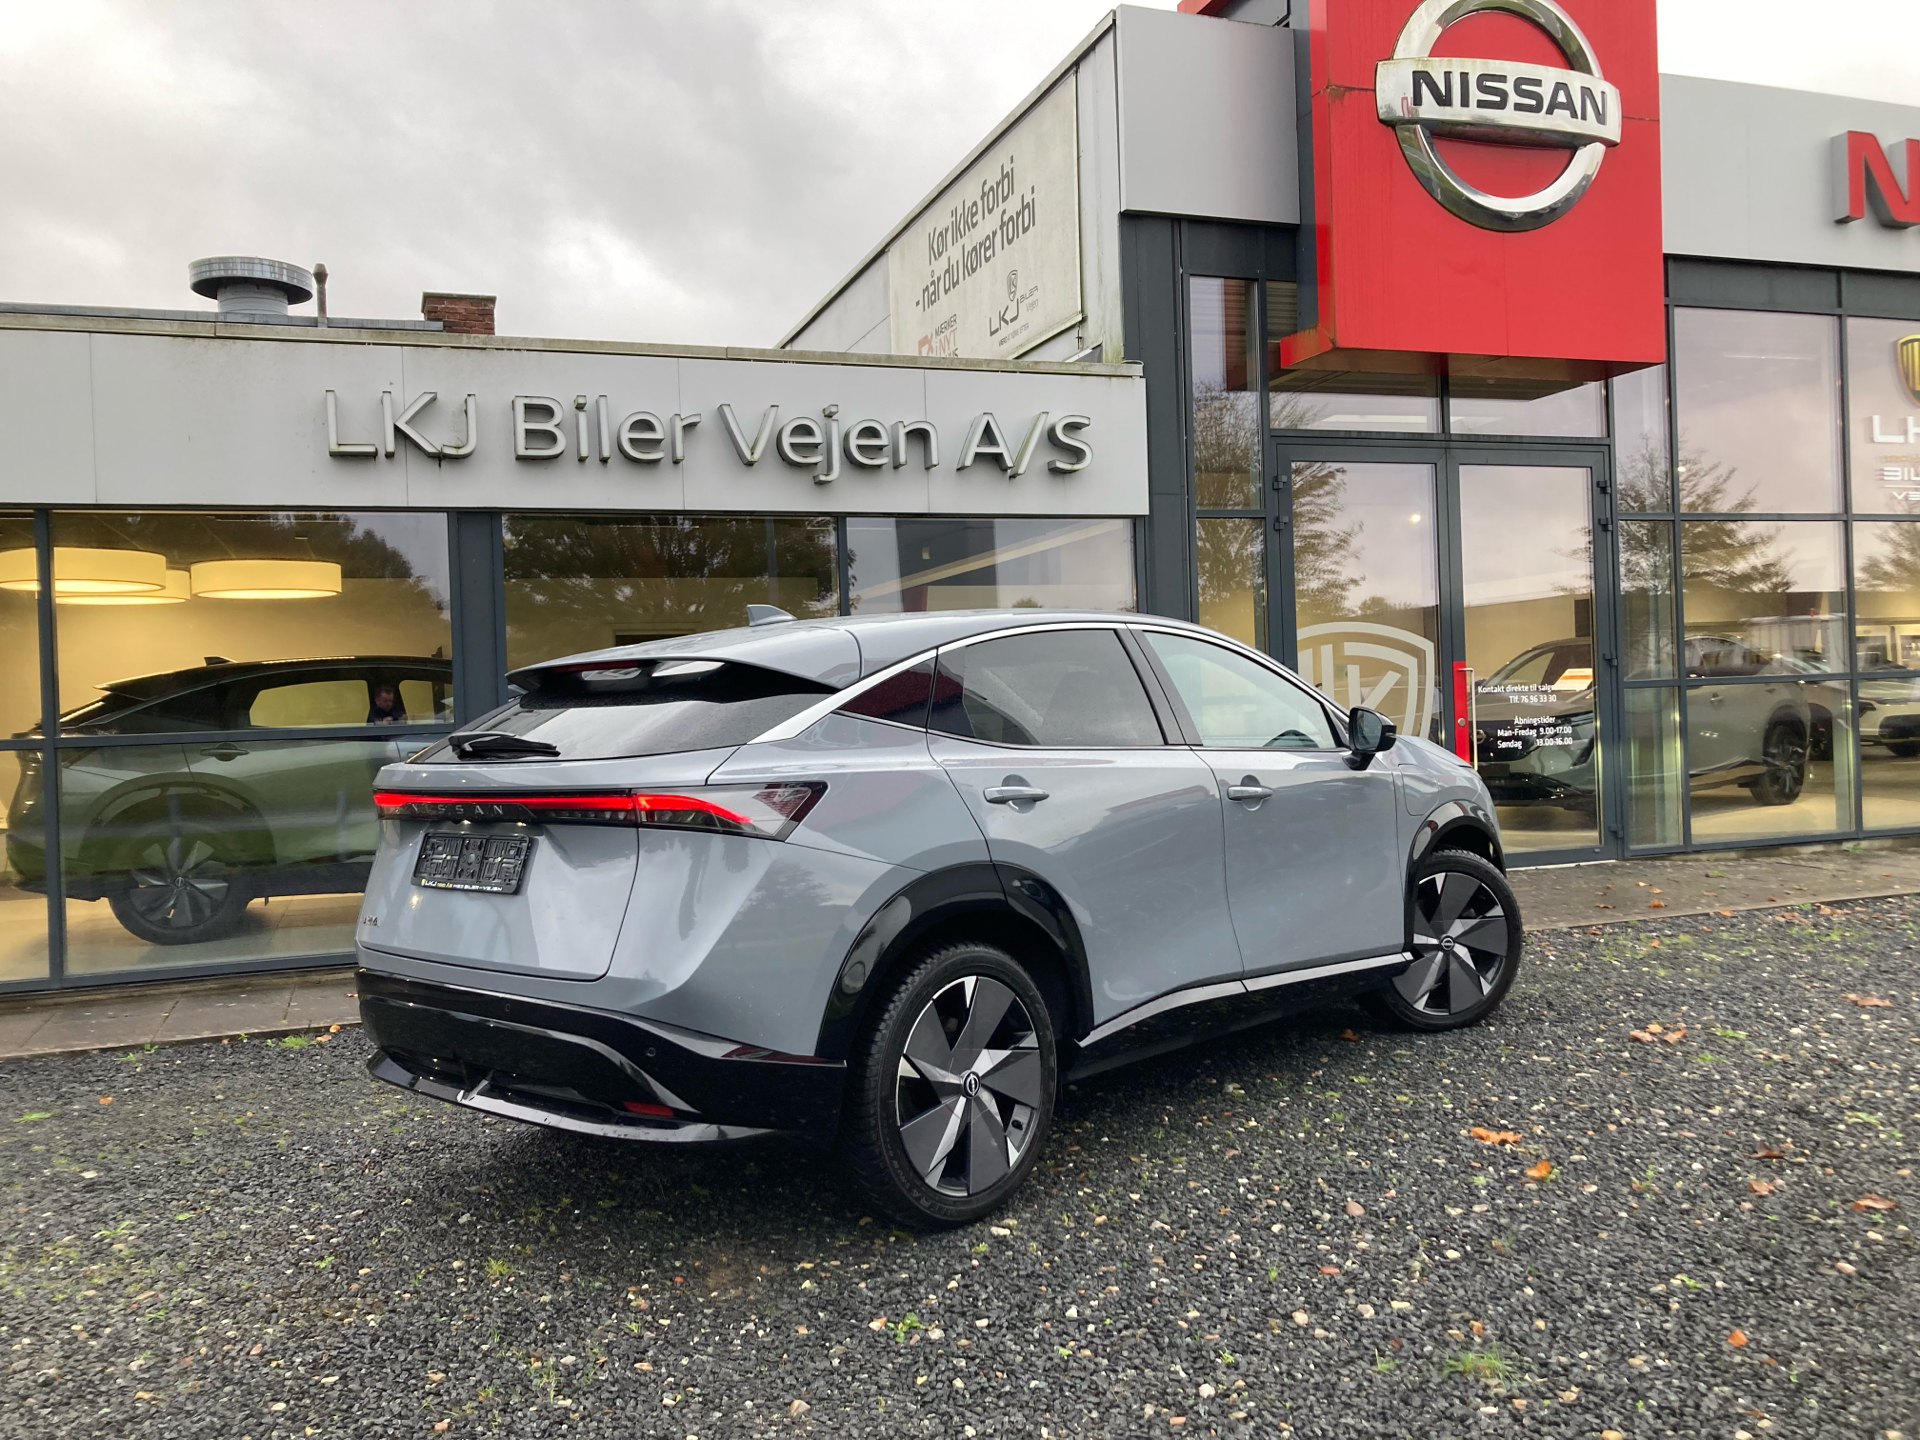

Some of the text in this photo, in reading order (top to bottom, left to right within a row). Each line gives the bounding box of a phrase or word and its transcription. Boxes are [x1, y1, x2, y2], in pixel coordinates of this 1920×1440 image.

[1412, 70, 1607, 126] NISSAN
[928, 155, 1014, 266] Kør ikke forbi
[922, 270, 941, 312] når
[943, 256, 959, 295] du
[962, 243, 997, 281] kører
[999, 185, 1035, 250] forbi
[989, 298, 1019, 336] LKJ
[325, 390, 1094, 485] LKJ Biler Vejen A/S
[1478, 685, 1505, 694] Kontakt
[1506, 684, 1530, 693] direkte
[1509, 694, 1557, 703] Tlf. 76 96 33 30
[1497, 726, 1573, 738] Man-Fredag 9.00-17.00
[1514, 716, 1556, 726] Åbningstider
[1497, 740, 1522, 749] Søndag
